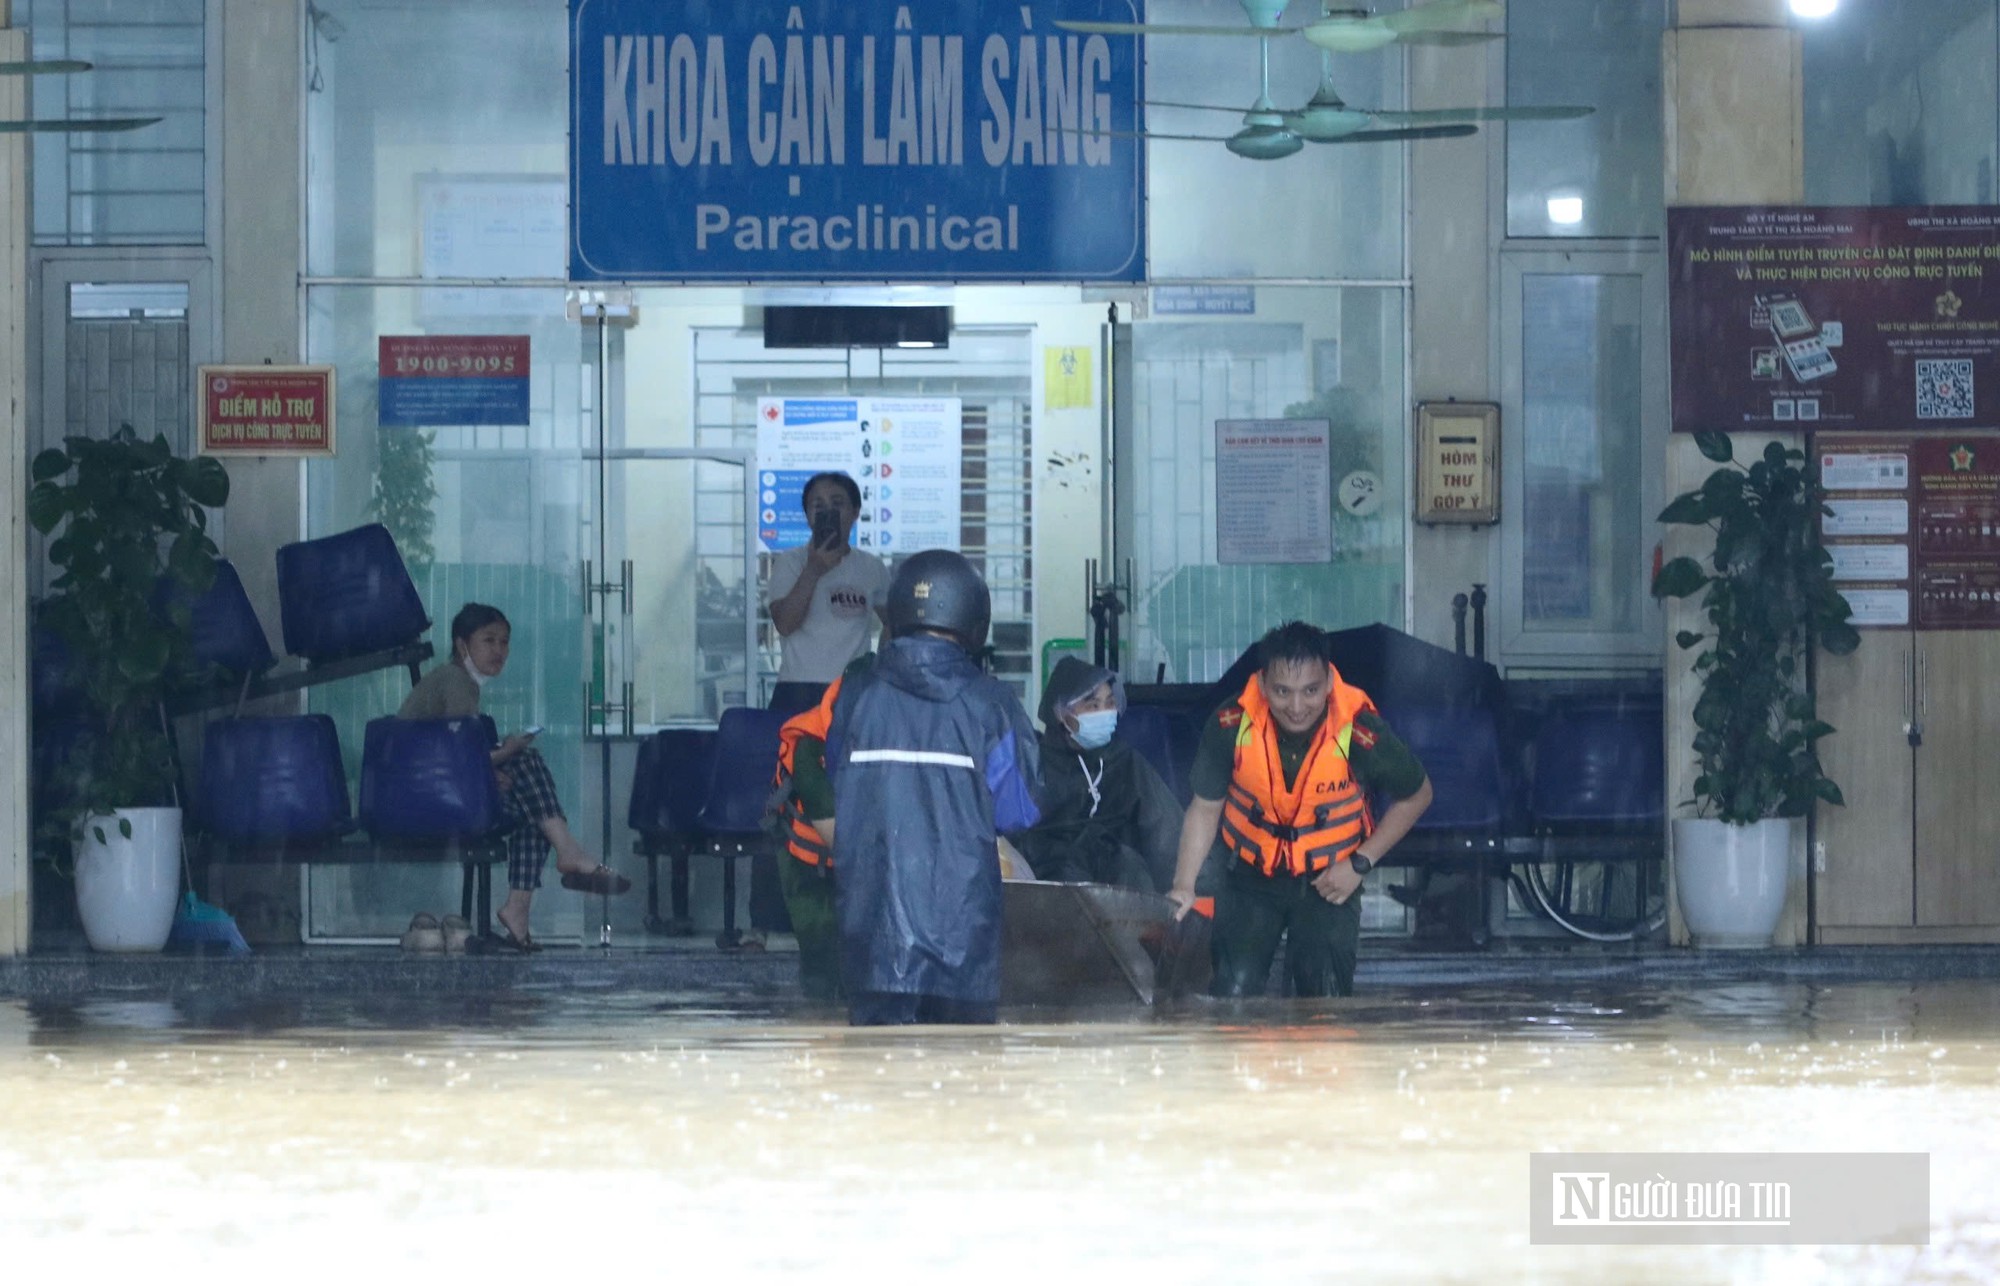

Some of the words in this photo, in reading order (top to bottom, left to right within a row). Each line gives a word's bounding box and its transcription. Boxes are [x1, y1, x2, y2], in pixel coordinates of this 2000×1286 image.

[603, 34, 732, 167] KHOA
[748, 5, 845, 196] CẬN
[863, 4, 964, 166] LÂM
[981, 5, 1112, 168] SÀNG
[1760, 214, 1766, 222] Y
[1802, 214, 1815, 222] AN
[1993, 216, 2000, 225] M
[695, 204, 1019, 252] Paraclinical
[1709, 226, 1736, 235] TRUNG
[1758, 226, 1763, 234] Y
[1837, 225, 1853, 234] MAI
[1690, 247, 1710, 262] MÔ
[1714, 246, 1743, 262] HÌNH
[1778, 246, 1813, 261] TUYÊN
[1817, 243, 1859, 261] TRUYỀN
[1863, 244, 1884, 260] CÀI
[1914, 246, 1944, 262] ĐỊNH
[1946, 246, 1980, 259] DANH
[1983, 243, 2000, 261] ĐIỆ
[1736, 265, 1752, 280] VÀ
[1756, 267, 1787, 282] THỰC
[1791, 265, 1818, 282] HIỆN
[1821, 267, 1850, 282] DỊCH
[1854, 266, 1870, 281] VỤ
[1874, 264, 1910, 279] CÔNG
[1914, 265, 1943, 281] TRỰC
[1947, 261, 1982, 278] TUYẾN
[395, 356, 515, 372] 1900-9095
[286, 397, 315, 421] TRỢ
[211, 423, 232, 441] DỊCH
[233, 423, 245, 441] VỤ
[246, 420, 269, 439] CÔNG
[1441, 449, 1477, 466] HÒM
[1443, 474, 1474, 487] THƯ
[1433, 493, 1465, 509] GÓP
[1471, 493, 1480, 509] Ý
[831, 592, 867, 605] HELLO
[1315, 779, 1349, 794] CAN
